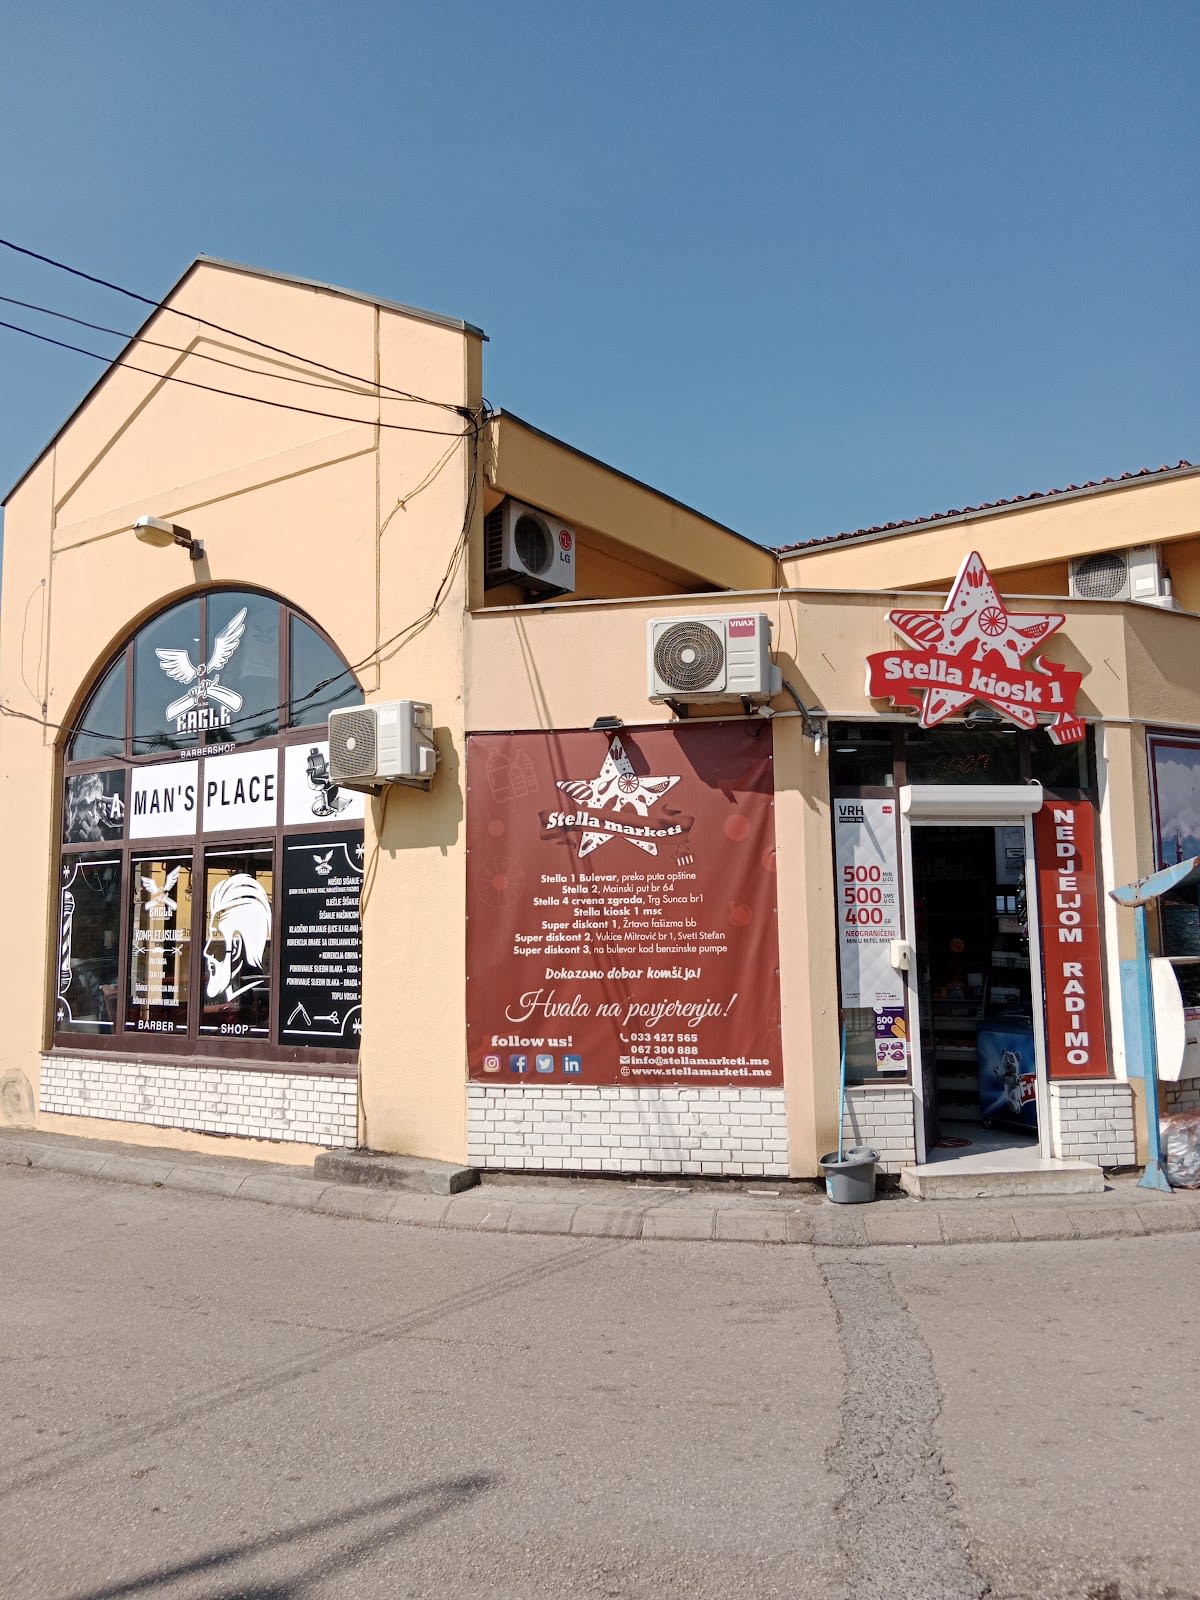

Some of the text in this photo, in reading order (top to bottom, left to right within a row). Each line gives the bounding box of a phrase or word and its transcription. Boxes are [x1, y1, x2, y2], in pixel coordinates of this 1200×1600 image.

[560, 552, 570, 564] LG
[729, 619, 754, 627] VIVAX
[884, 657, 1063, 703] Stella kiosk 1
[177, 706, 231, 735] EAGLE
[181, 743, 235, 759] BARBERSHOP
[135, 786, 194, 815] MAN'S
[208, 775, 274, 807] PLACE
[839, 806, 863, 815] VRH
[545, 811, 682, 837] Stella marketi
[541, 871, 696, 883] Stella 1 Bulevar, preko puta opštine
[844, 866, 881, 882] 500
[562, 883, 674, 894] Stella 2, Mainski put br 64
[534, 897, 559, 905] Stella
[608, 895, 645, 906] zgrada,
[648, 895, 660, 905] Trg
[663, 895, 687, 903] Sunca
[690, 893, 702, 902] br1
[844, 887, 882, 904] 500
[574, 907, 600, 916] Stella
[604, 907, 630, 915] kiosk
[845, 908, 883, 924] 400
[542, 917, 696, 931] Super diskont 1, Žrtava fašizma bb
[515, 931, 725, 944] Super diskont 2, Vukice Mitrović br 1, Sveti Stefan
[1054, 809, 1089, 1065] NEDJELJOM RADIMO
[514, 946, 541, 956] Super
[544, 945, 580, 954] diskont
[583, 945, 591, 954] 3,
[607, 944, 636, 953] bulevar
[639, 944, 653, 953] kod
[656, 943, 696, 952] benzinske
[699, 946, 727, 954] pumpe
[545, 966, 700, 980] Dokazano dobar komšija!
[506, 989, 737, 1027] Hvala na povjerenju!
[138, 1020, 174, 1031] BARBER
[876, 1016, 893, 1024] 500
[221, 1024, 248, 1034] SHOP
[492, 1036, 572, 1046] follow us!
[631, 1033, 697, 1042] 033 427 565
[654, 1046, 674, 1054] 300
[631, 1056, 769, 1066] info@stellamarketi.me
[632, 1067, 772, 1076] www.stellamarketi.me
